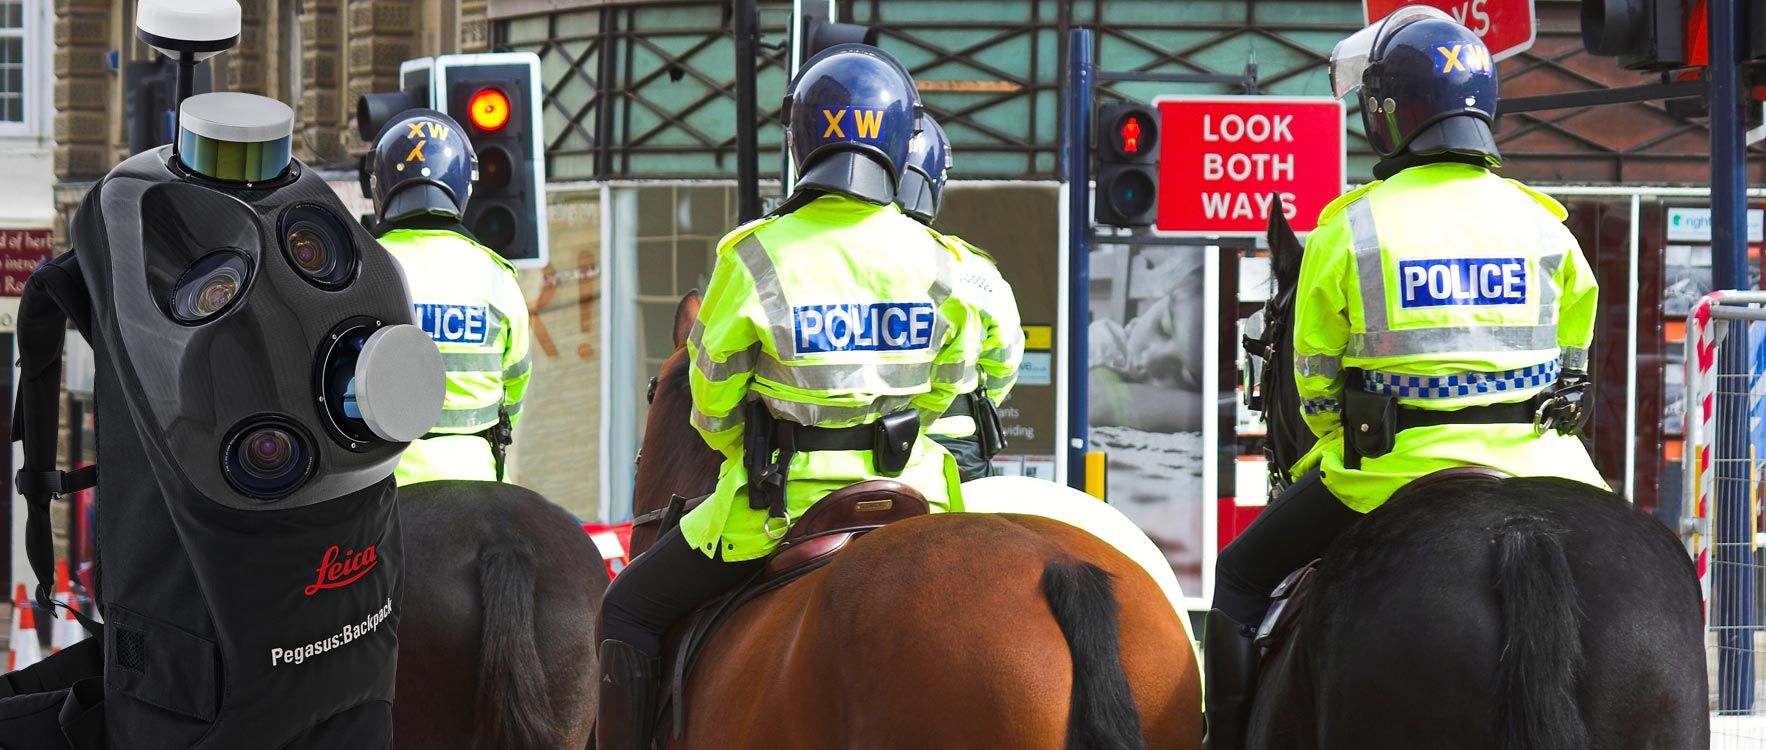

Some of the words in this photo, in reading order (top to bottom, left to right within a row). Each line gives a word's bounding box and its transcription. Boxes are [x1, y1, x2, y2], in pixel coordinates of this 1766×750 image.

[1203, 114, 1294, 142] LOOK
[1203, 153, 1295, 181] BOTH
[1201, 192, 1298, 220] WAYS
[9, 231, 22, 251] of
[1404, 263, 1522, 301] POLICE
[799, 306, 933, 348] POLICE
[304, 545, 378, 596] Leica
[271, 597, 393, 667] Pegasus:Backpack
